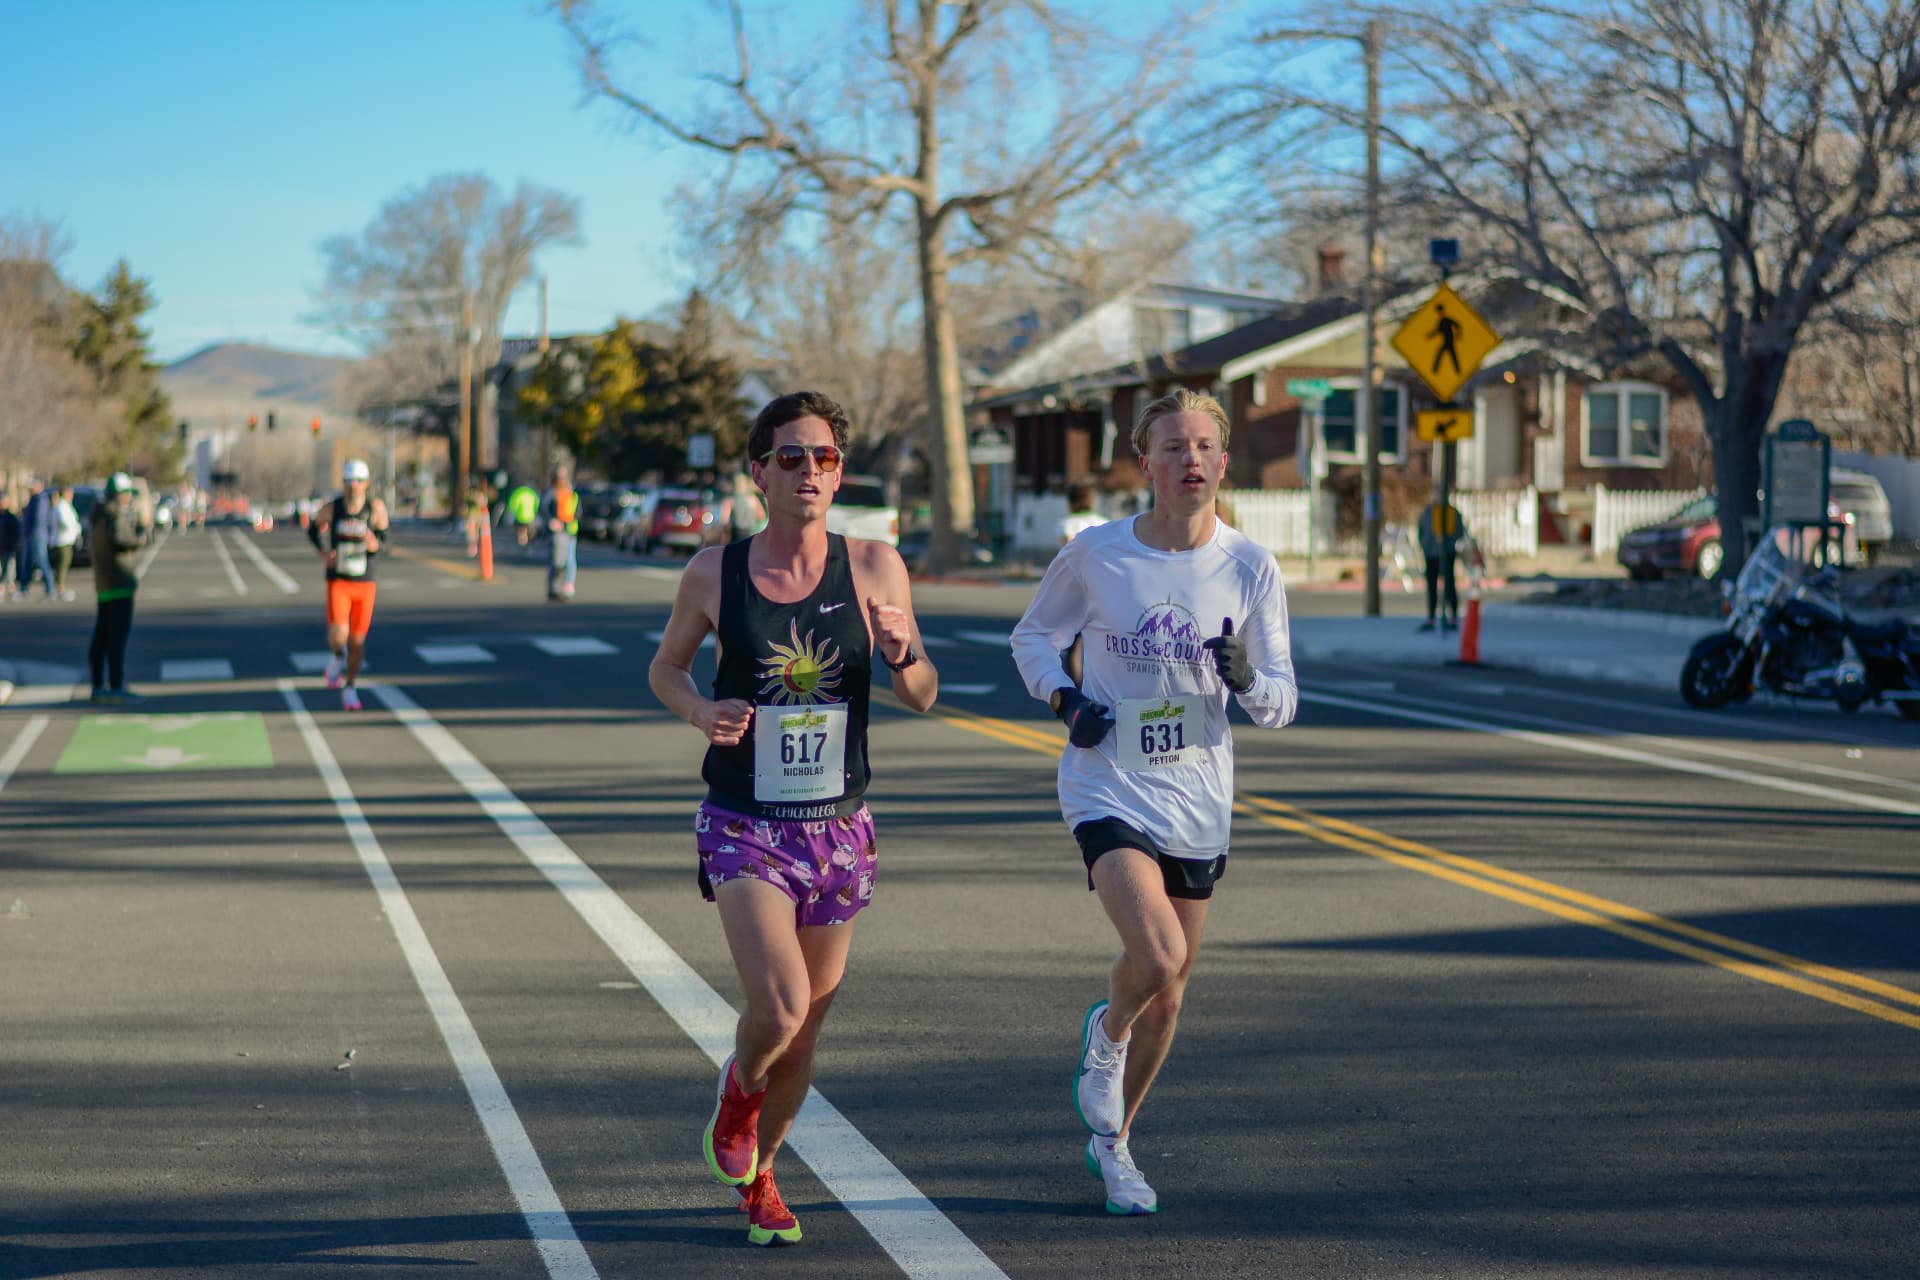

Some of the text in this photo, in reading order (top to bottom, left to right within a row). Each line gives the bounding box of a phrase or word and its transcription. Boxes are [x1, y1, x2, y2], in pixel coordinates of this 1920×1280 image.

[1106, 634, 1215, 663] CROSS COUNT
[1126, 662, 1203, 678] SPANISH SPRINGS
[780, 732, 828, 764] 617
[1140, 722, 1186, 754] 631
[1149, 754, 1180, 766] PEYTON
[783, 766, 824, 777] NICHOLAS
